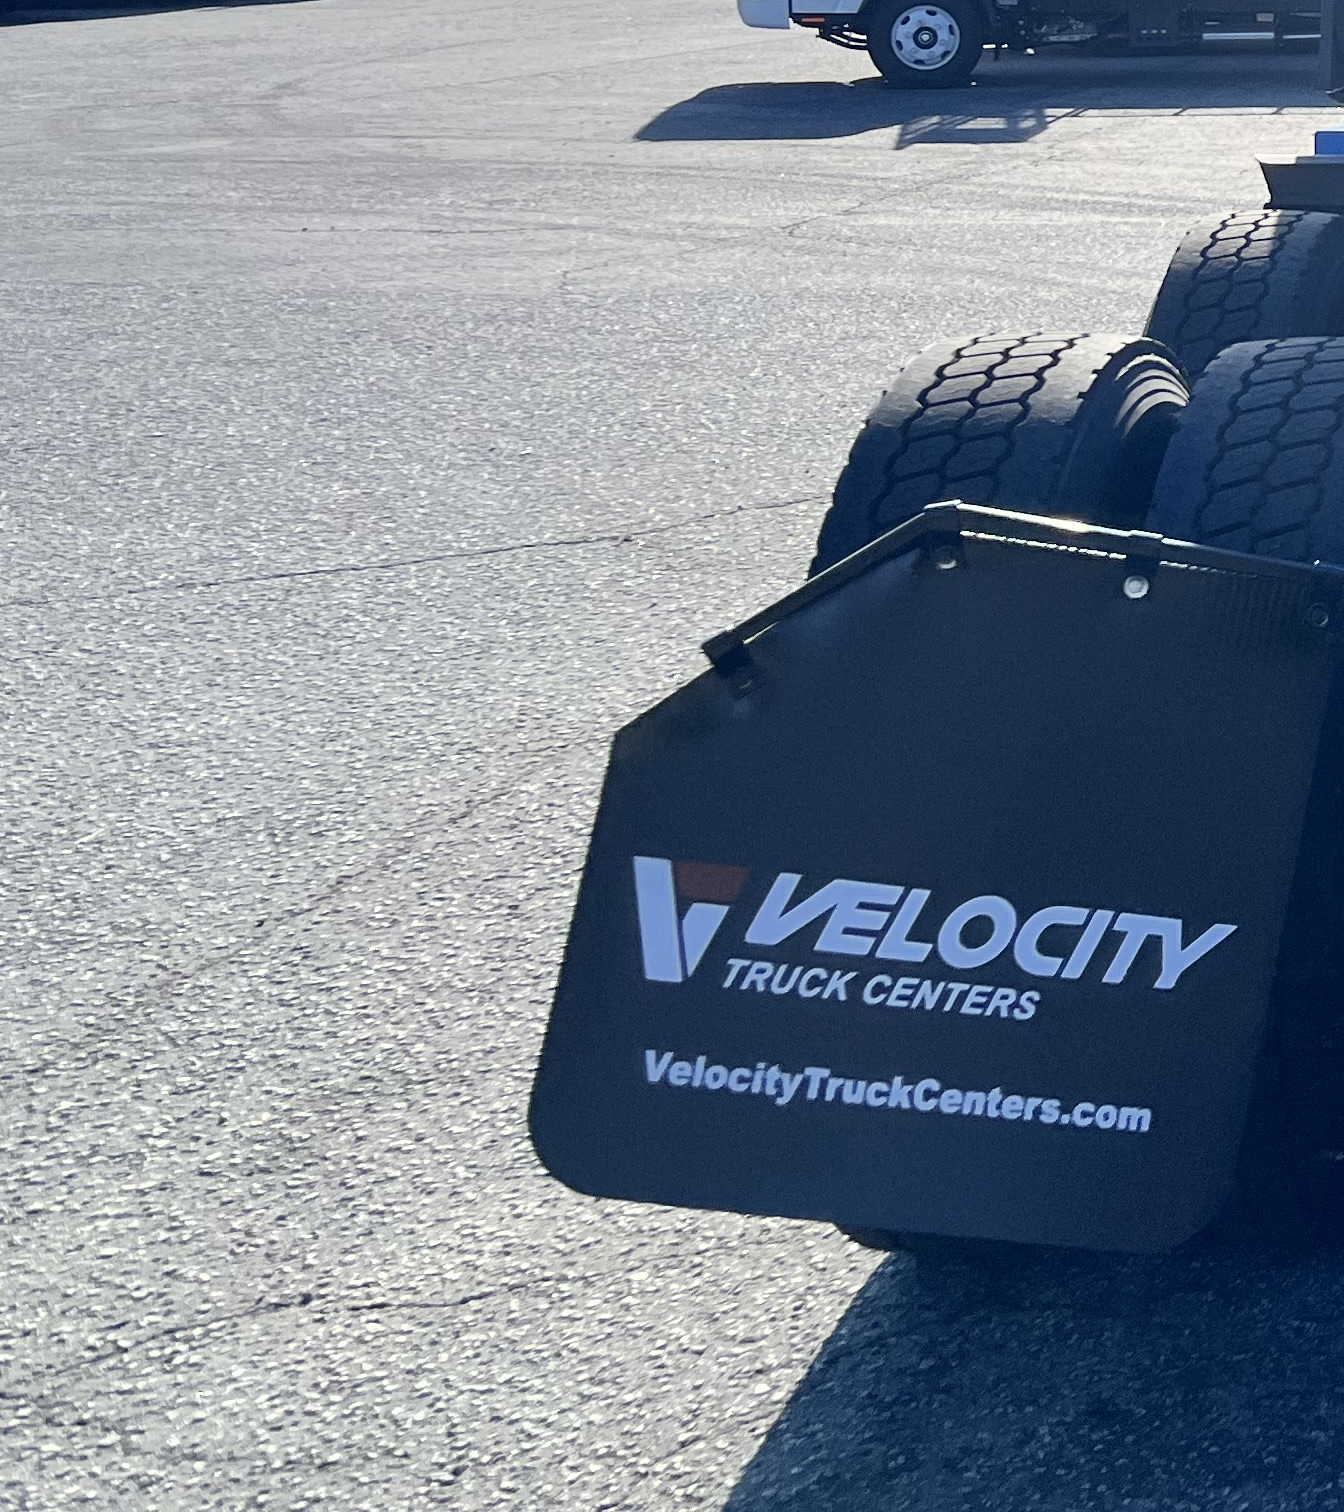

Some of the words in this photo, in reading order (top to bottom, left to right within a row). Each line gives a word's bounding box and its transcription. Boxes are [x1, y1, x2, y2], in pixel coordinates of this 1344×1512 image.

[744, 872, 1238, 990] VELOCITY
[723, 958, 857, 1005] TRUCK
[862, 974, 1041, 1020] CENTERS
[645, 1050, 1152, 1133] VelocityTruckCenters.com
